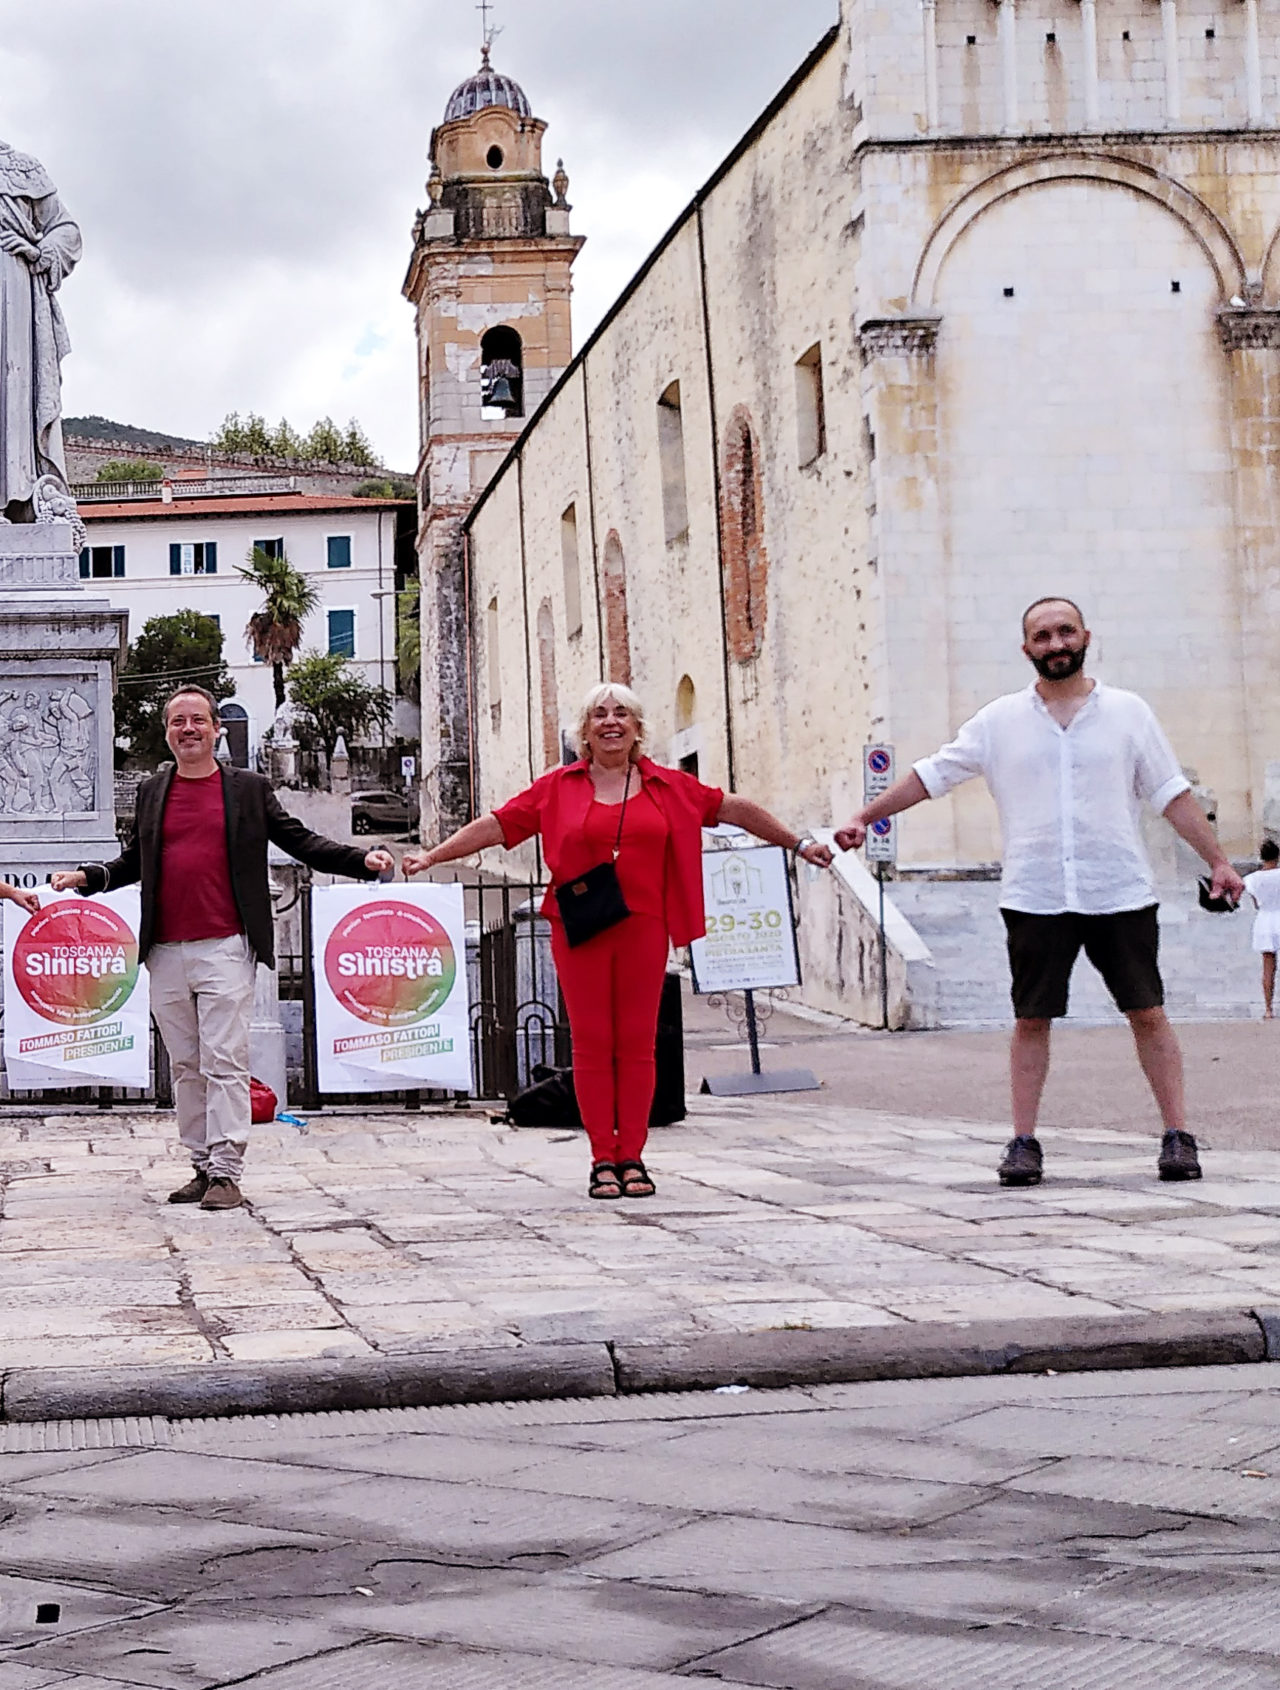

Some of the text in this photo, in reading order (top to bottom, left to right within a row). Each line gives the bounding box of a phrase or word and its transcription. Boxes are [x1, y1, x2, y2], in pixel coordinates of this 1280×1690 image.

[705, 909, 782, 934] 29-30
[52, 946, 126, 958] TOSCANA A
[365, 946, 442, 959] TOSCANA A
[21, 1023, 121, 1051] TOMMASO FATTORI
[65, 1037, 132, 1060] PRESIDENTE
[335, 1025, 439, 1052] TOMMASO FATTORI
[383, 1041, 452, 1061] PRESIDENTE
